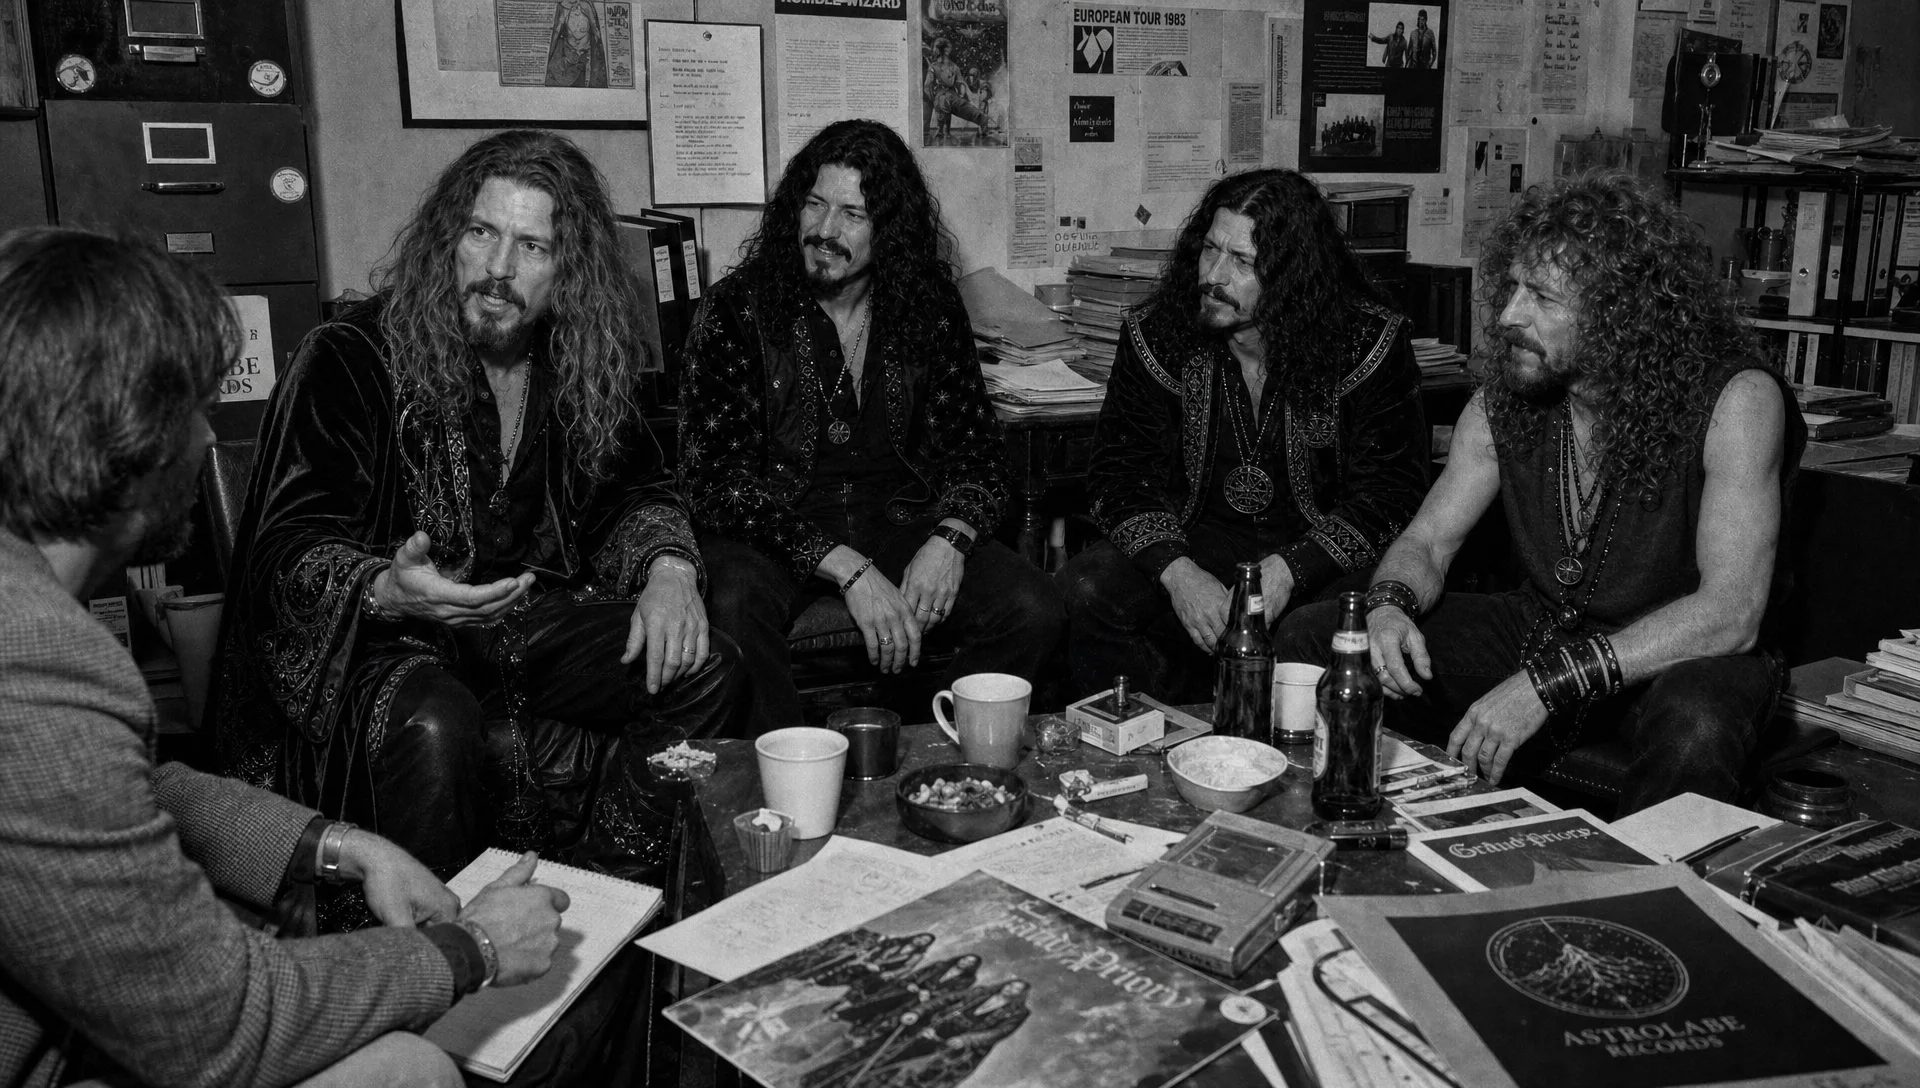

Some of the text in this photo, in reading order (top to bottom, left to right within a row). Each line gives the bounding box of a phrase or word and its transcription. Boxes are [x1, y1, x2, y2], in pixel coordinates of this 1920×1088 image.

[1073, 8, 1186, 26] EUROPEAN TOUR 1983
[1563, 1015, 1746, 1047] ASTROLABE
[1605, 1034, 1724, 1058] RECORDS
